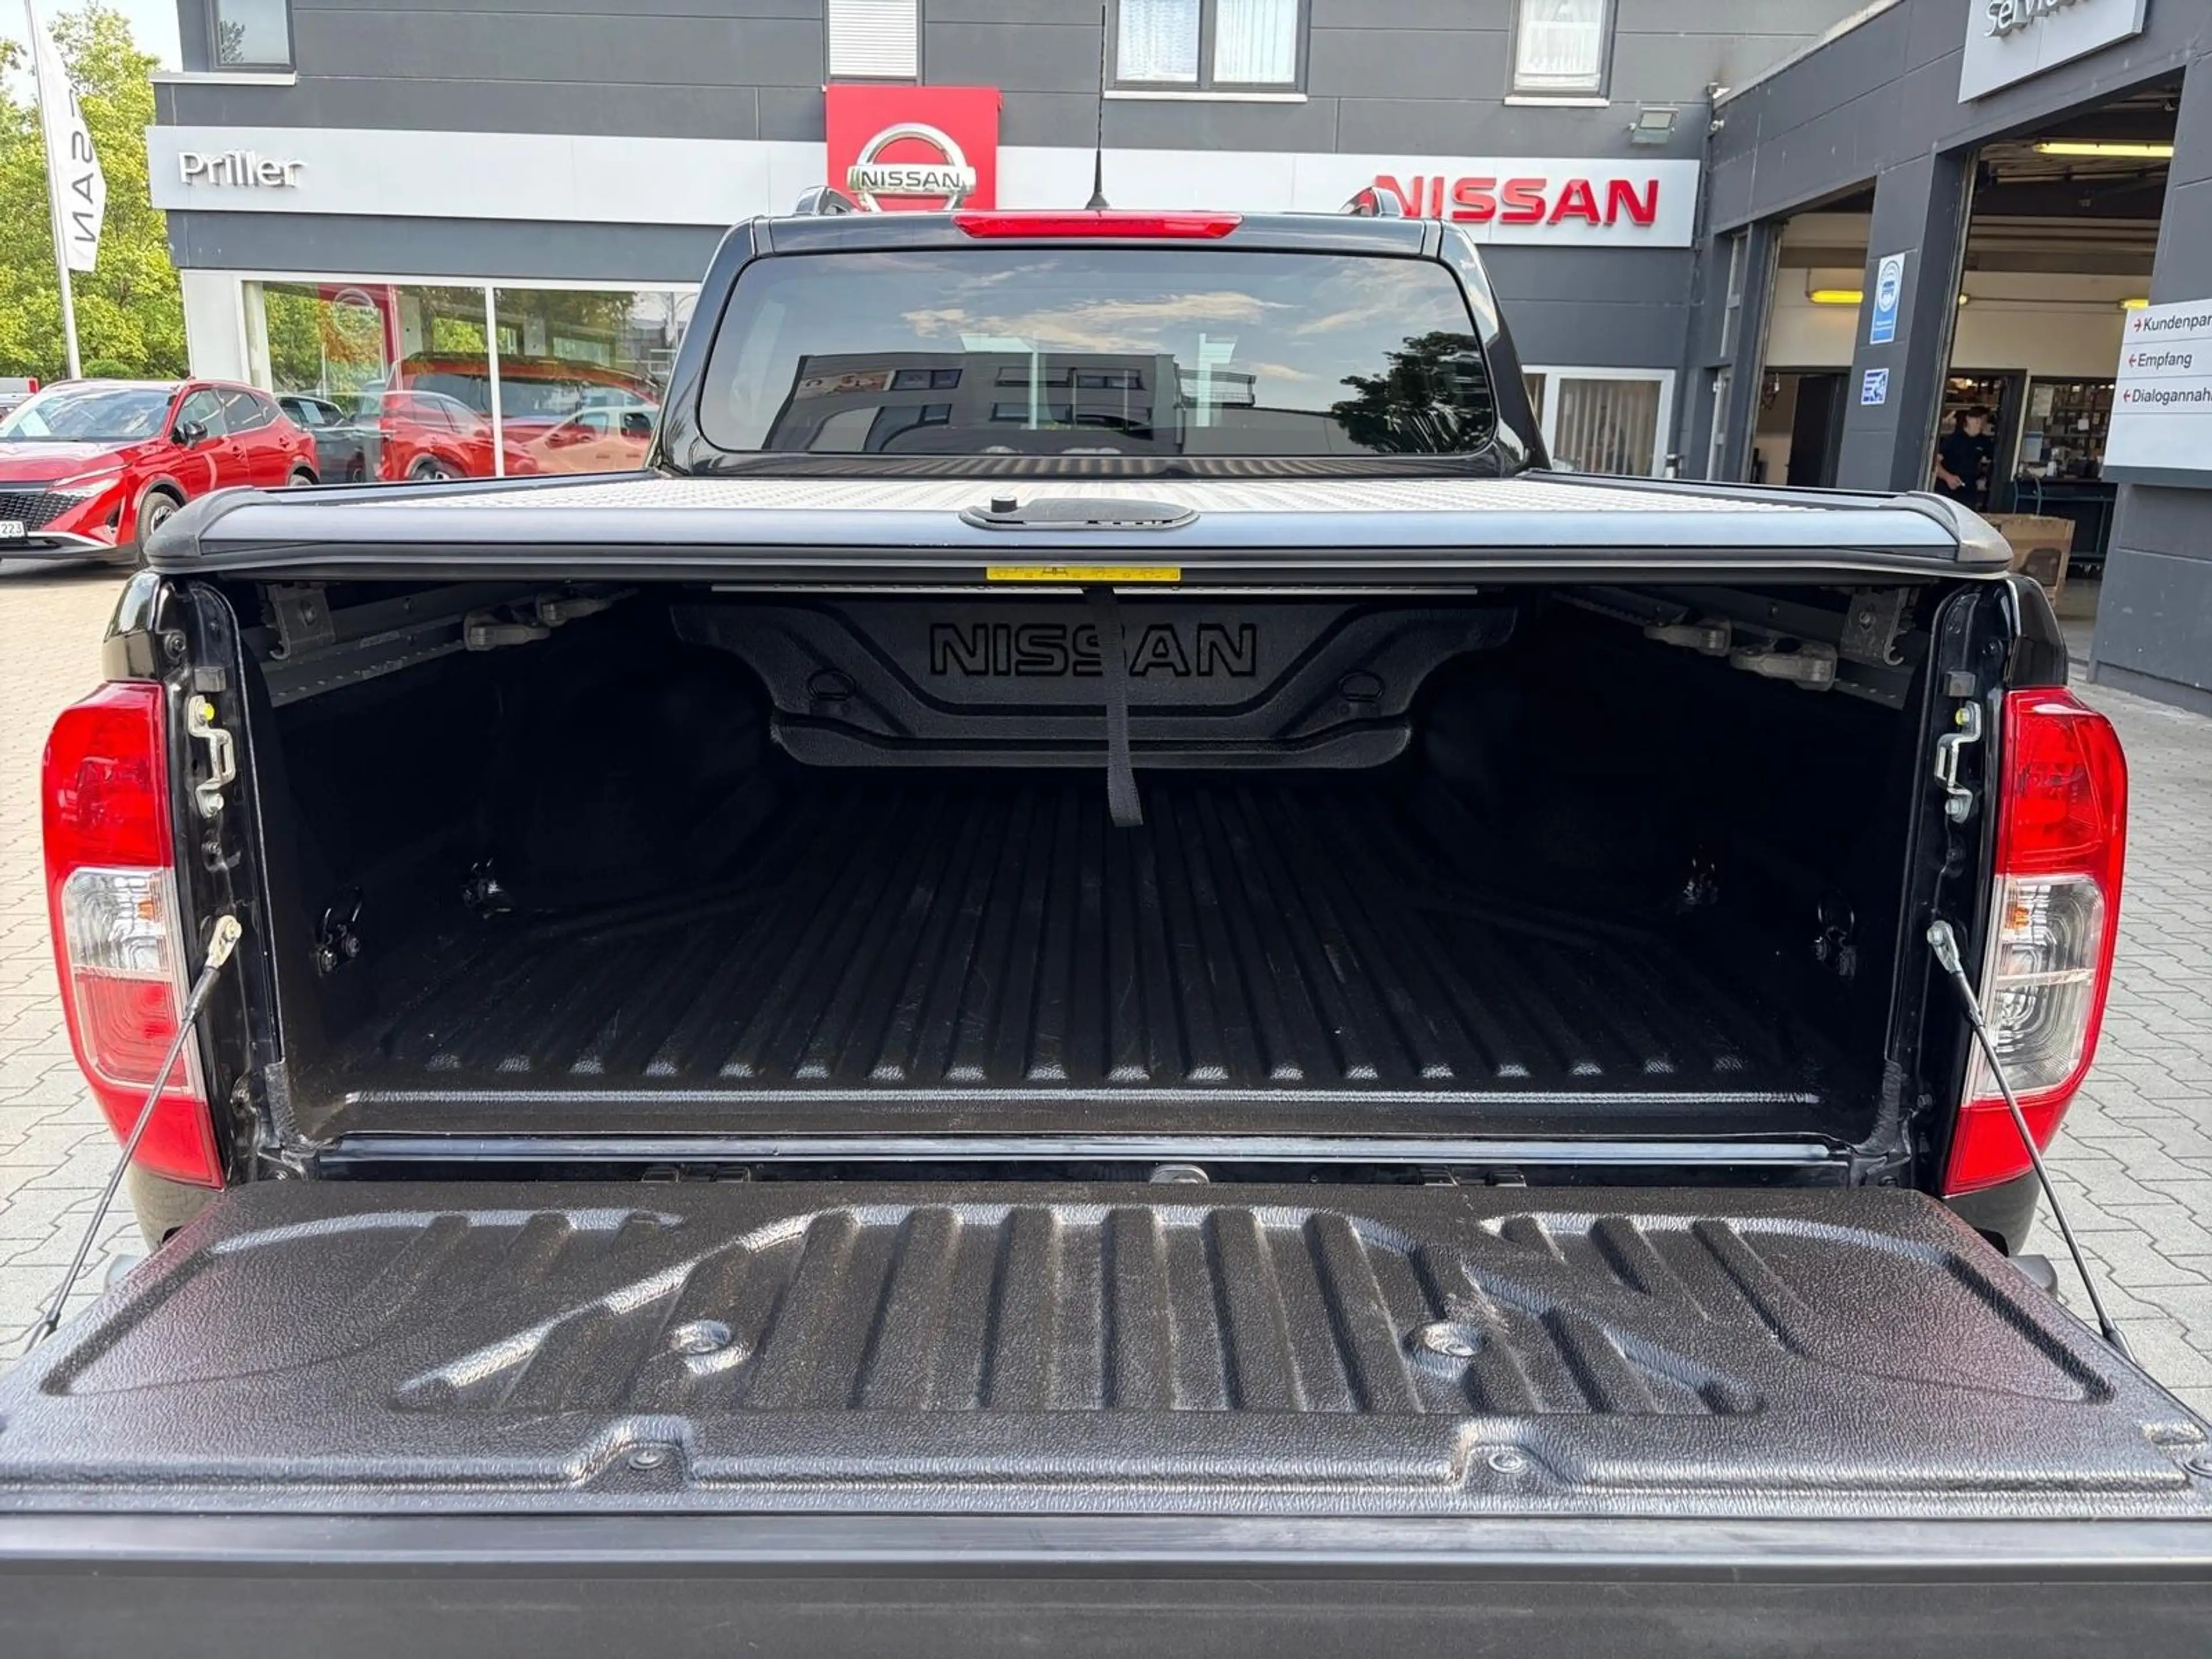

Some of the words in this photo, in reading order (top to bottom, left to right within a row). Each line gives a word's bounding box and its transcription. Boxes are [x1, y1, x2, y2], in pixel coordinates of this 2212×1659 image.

[177, 147, 308, 186] Priller
[861, 171, 960, 188] NISSAN
[2137, 351, 2192, 370] Empfang
[2132, 387, 2212, 406] Dialogannah
